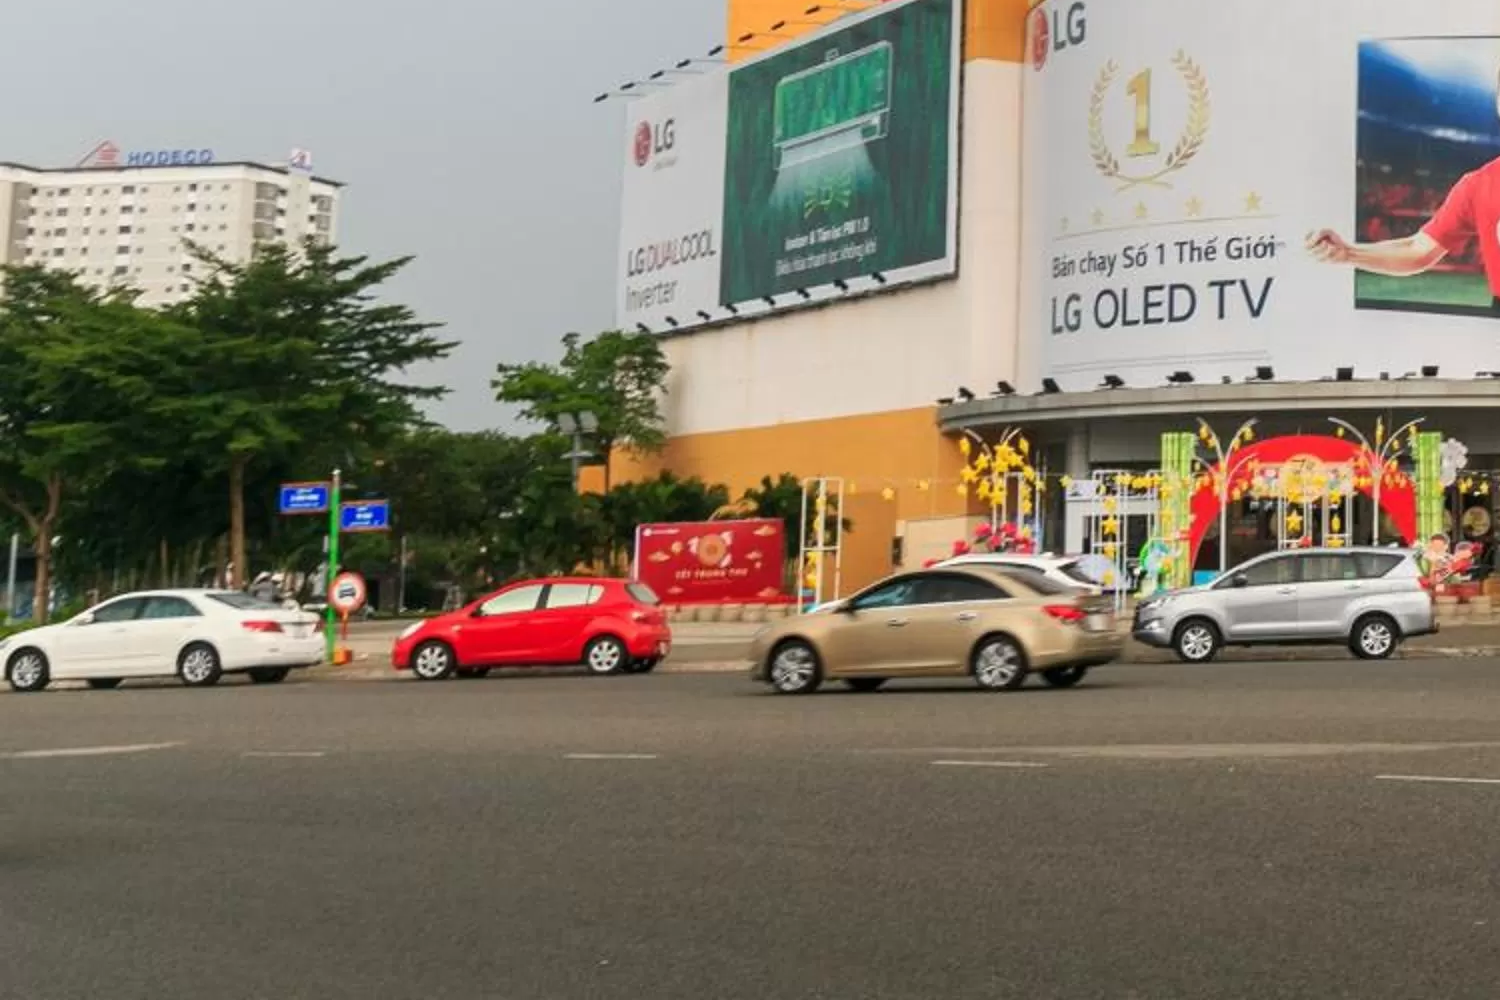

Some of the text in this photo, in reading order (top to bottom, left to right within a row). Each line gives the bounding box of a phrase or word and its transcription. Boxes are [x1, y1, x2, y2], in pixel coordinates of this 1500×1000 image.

[1053, 1, 1086, 51] LG
[1126, 68, 1160, 158] 1
[653, 117, 676, 155] LG
[128, 148, 215, 165] HODECO
[628, 247, 646, 278] LG
[1122, 243, 1149, 269] Số
[1155, 243, 1165, 265] 1
[1174, 236, 1218, 264] Thế
[1225, 235, 1276, 261] Giới
[1051, 277, 1274, 335] LG OLED TV
